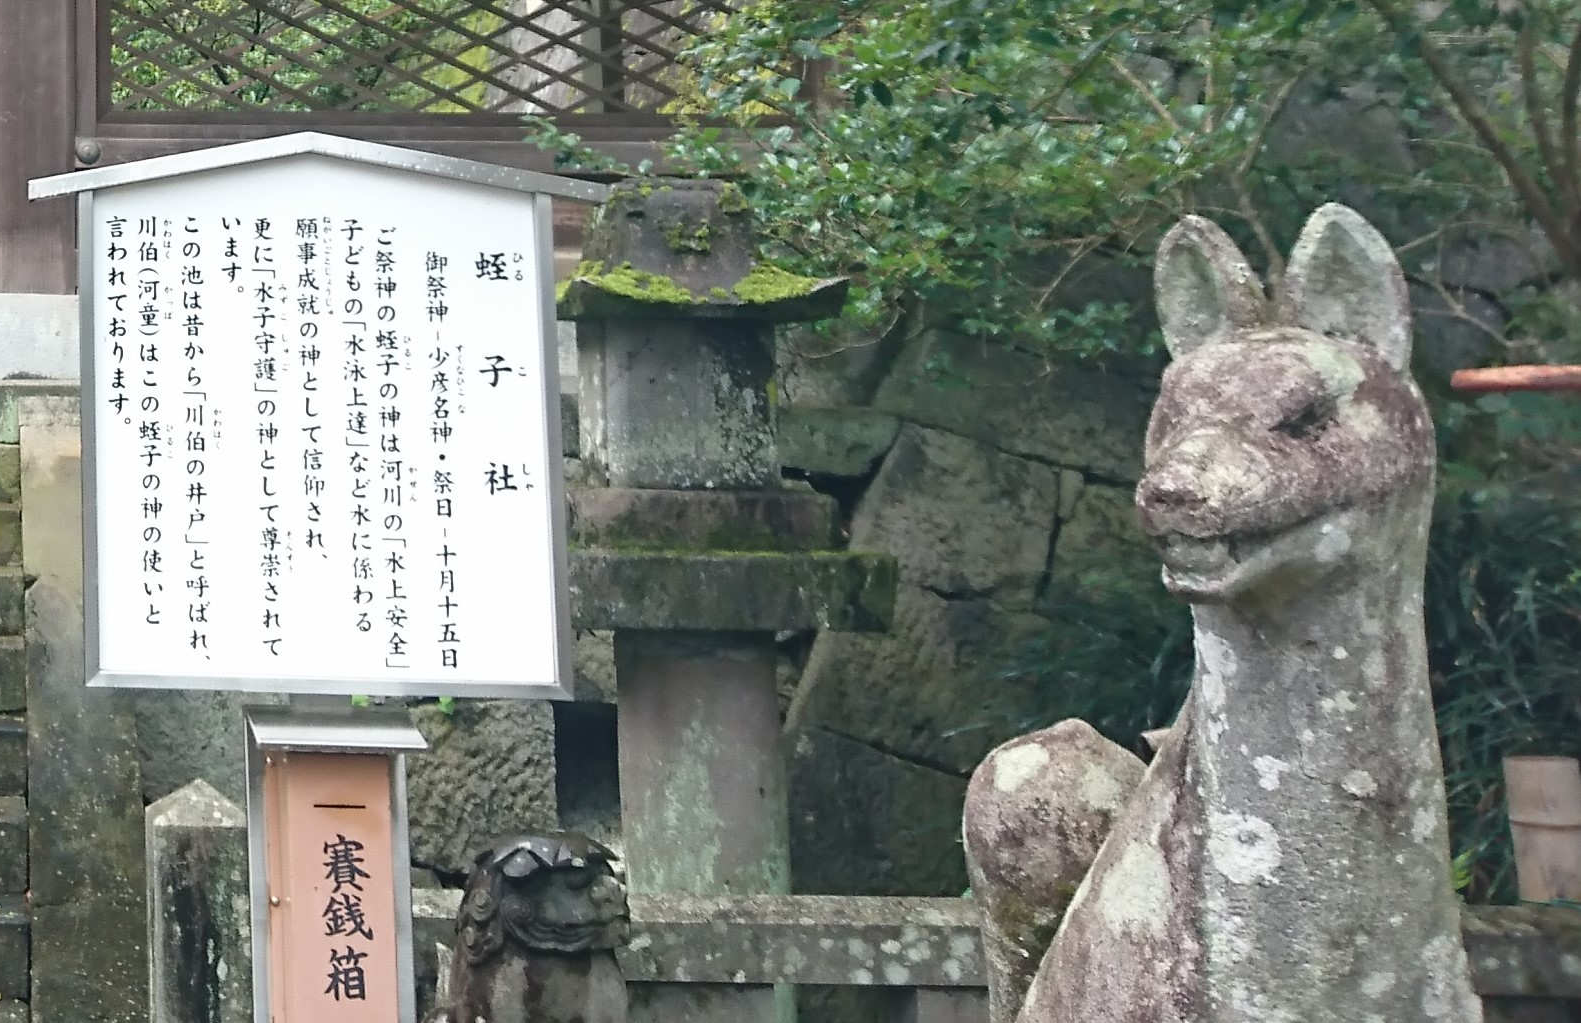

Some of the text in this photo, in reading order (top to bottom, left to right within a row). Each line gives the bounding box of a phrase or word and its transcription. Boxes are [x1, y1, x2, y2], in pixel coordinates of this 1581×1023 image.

[104, 215, 132, 425] 言われております。
[180, 216, 211, 661] この池は昔から「川伯の井戸」と呼ばれ、
[220, 216, 245, 294] います。
[251, 217, 283, 657] 更に「水子守護」の神として尊崇されて
[295, 217, 328, 559] 願事成就の神として信仰され、
[339, 218, 374, 633] 子どもの「水泳上達」など水に係わる
[373, 226, 409, 667] ご祭神の蛭子の神は河川の「水上安全」
[322, 833, 373, 1002] 賽銭箱
